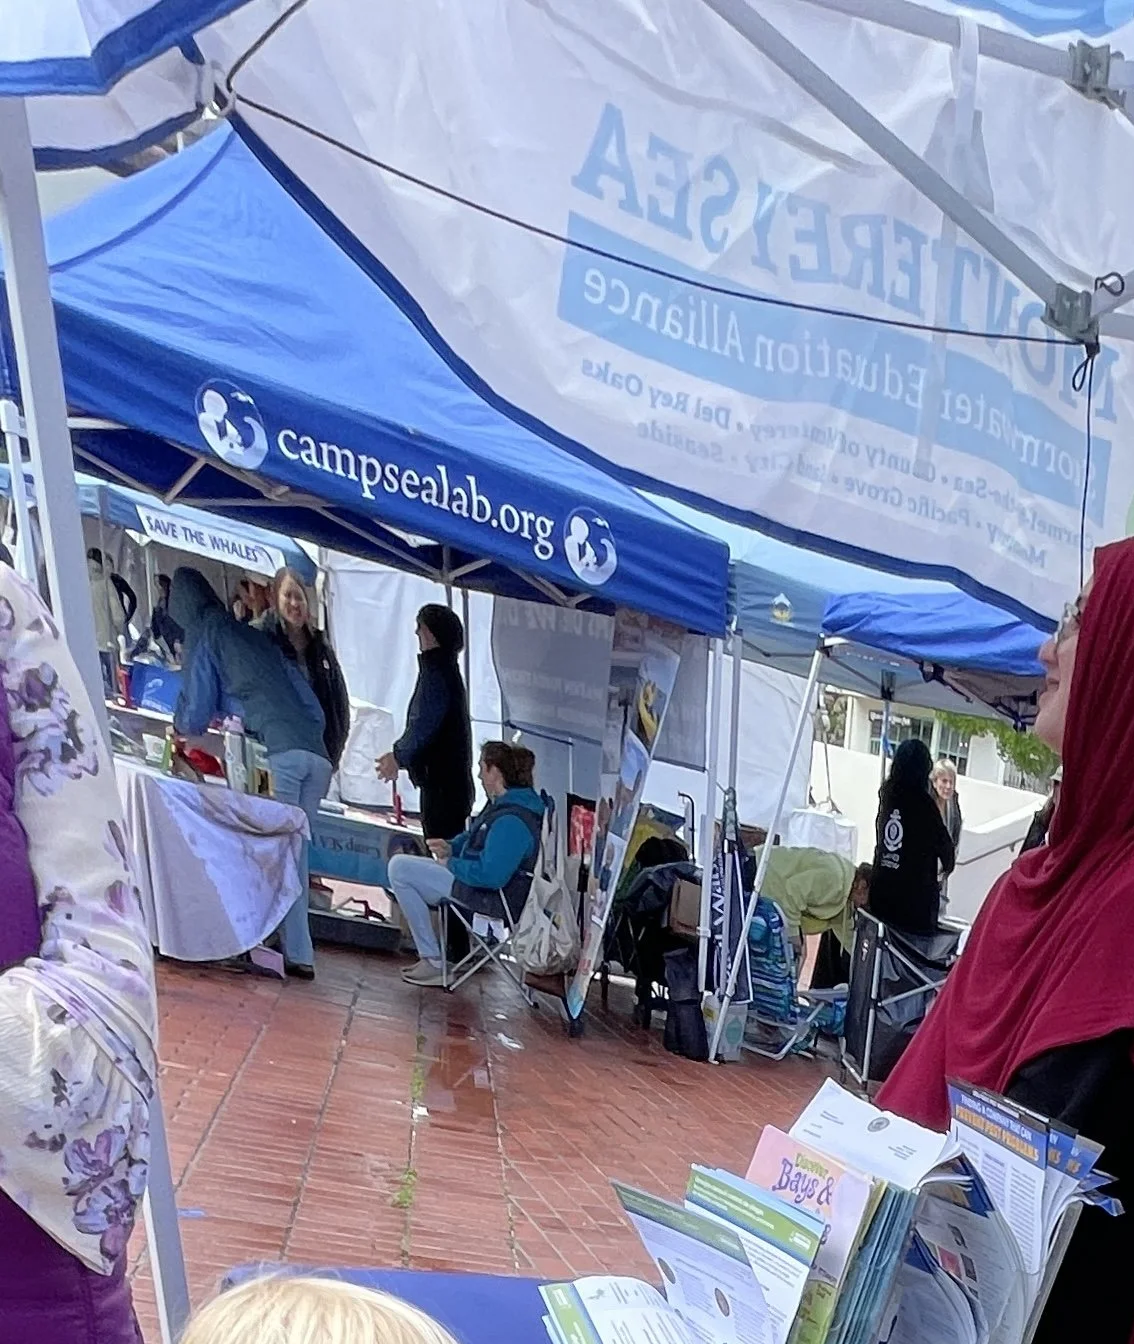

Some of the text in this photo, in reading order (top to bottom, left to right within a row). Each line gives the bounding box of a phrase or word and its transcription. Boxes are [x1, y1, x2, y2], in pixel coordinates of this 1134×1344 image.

[277, 429, 555, 560] campsealab.org
[146, 515, 259, 563] SAVE THE WHALES
[772, 1158, 819, 1204] Bays
[817, 1176, 835, 1206] &
